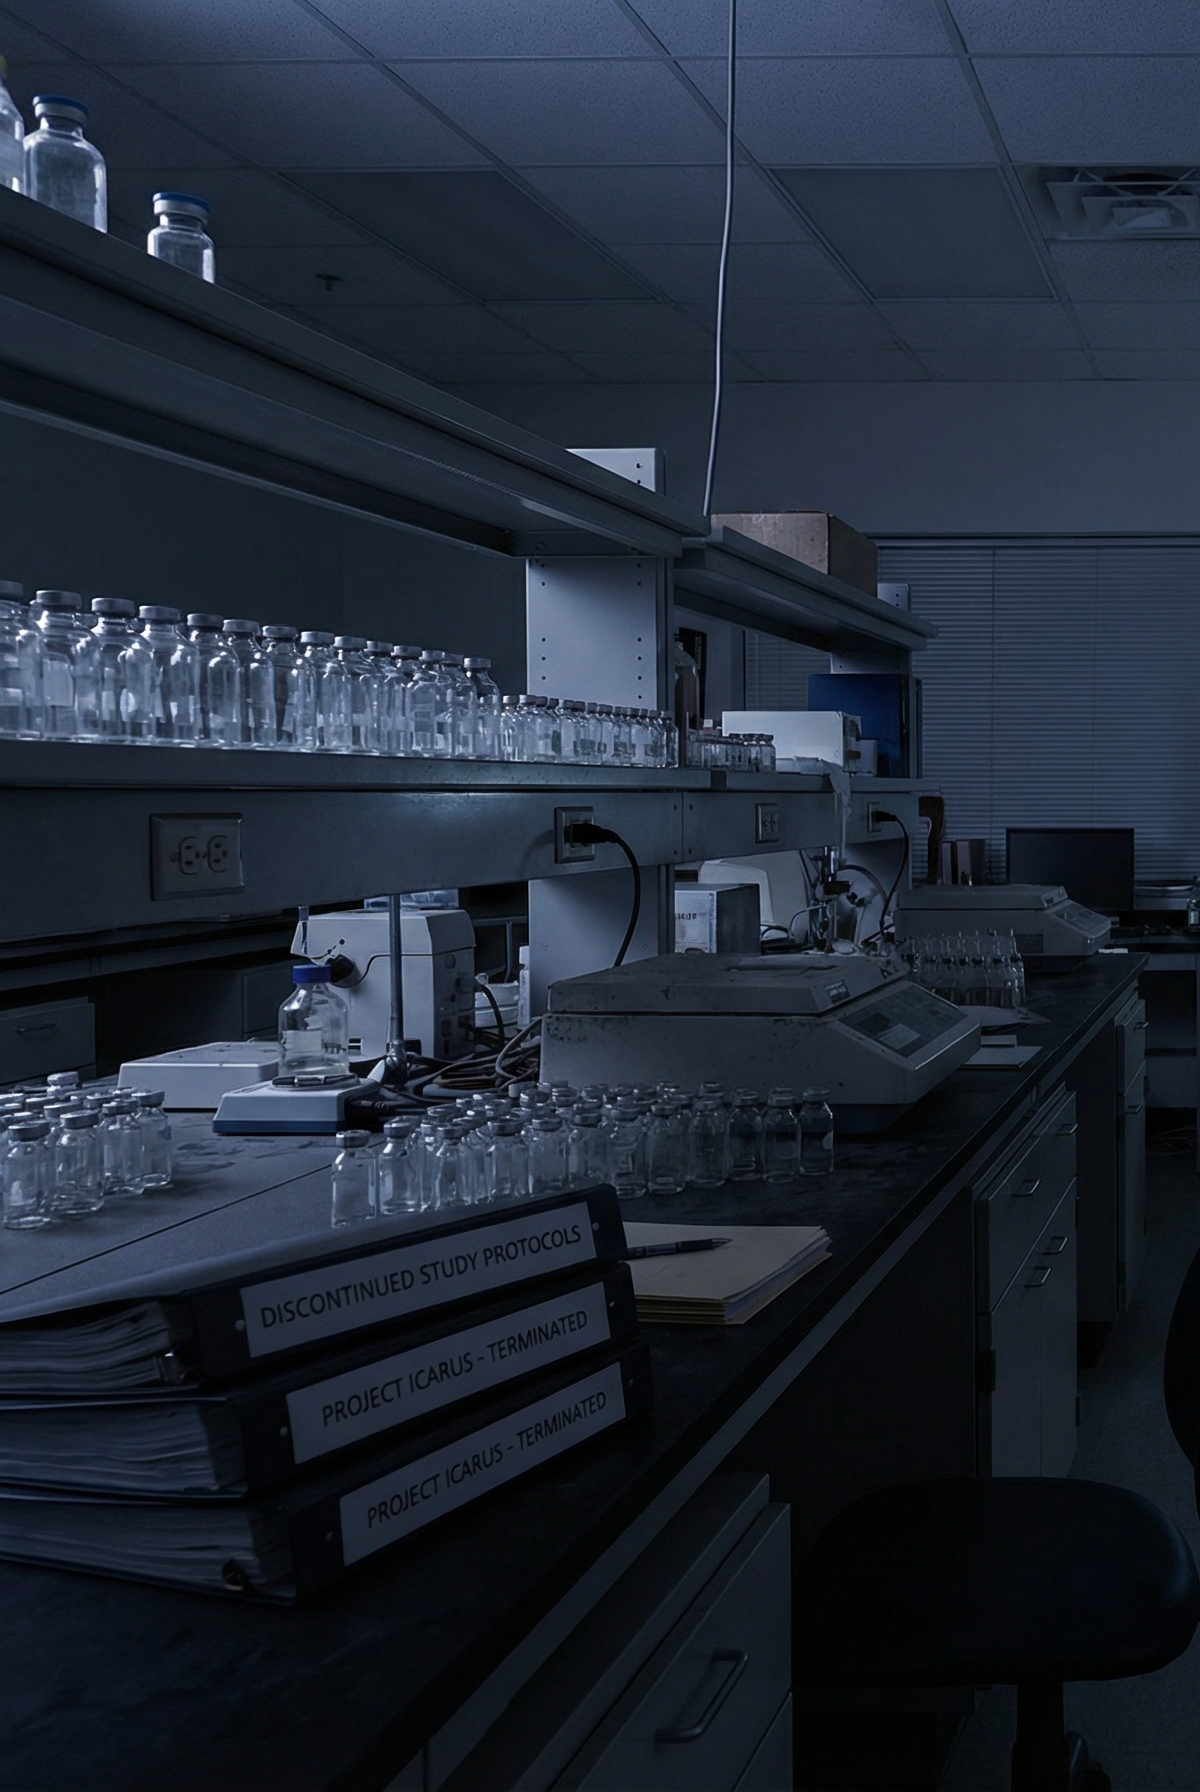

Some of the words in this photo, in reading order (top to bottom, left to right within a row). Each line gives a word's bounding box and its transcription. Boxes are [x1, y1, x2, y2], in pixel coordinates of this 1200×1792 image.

[260, 1269, 415, 1329] DISCONTINUED
[420, 1251, 479, 1286] STUDY
[483, 1224, 582, 1268] PROTOCOLS
[321, 1377, 405, 1427] PROJECT
[409, 1352, 474, 1394] ICARUS
[487, 1310, 589, 1363] TERMINATED
[366, 1473, 442, 1529] PROJECT
[445, 1443, 503, 1488] ICARUS
[515, 1391, 607, 1451] TERMINATED
